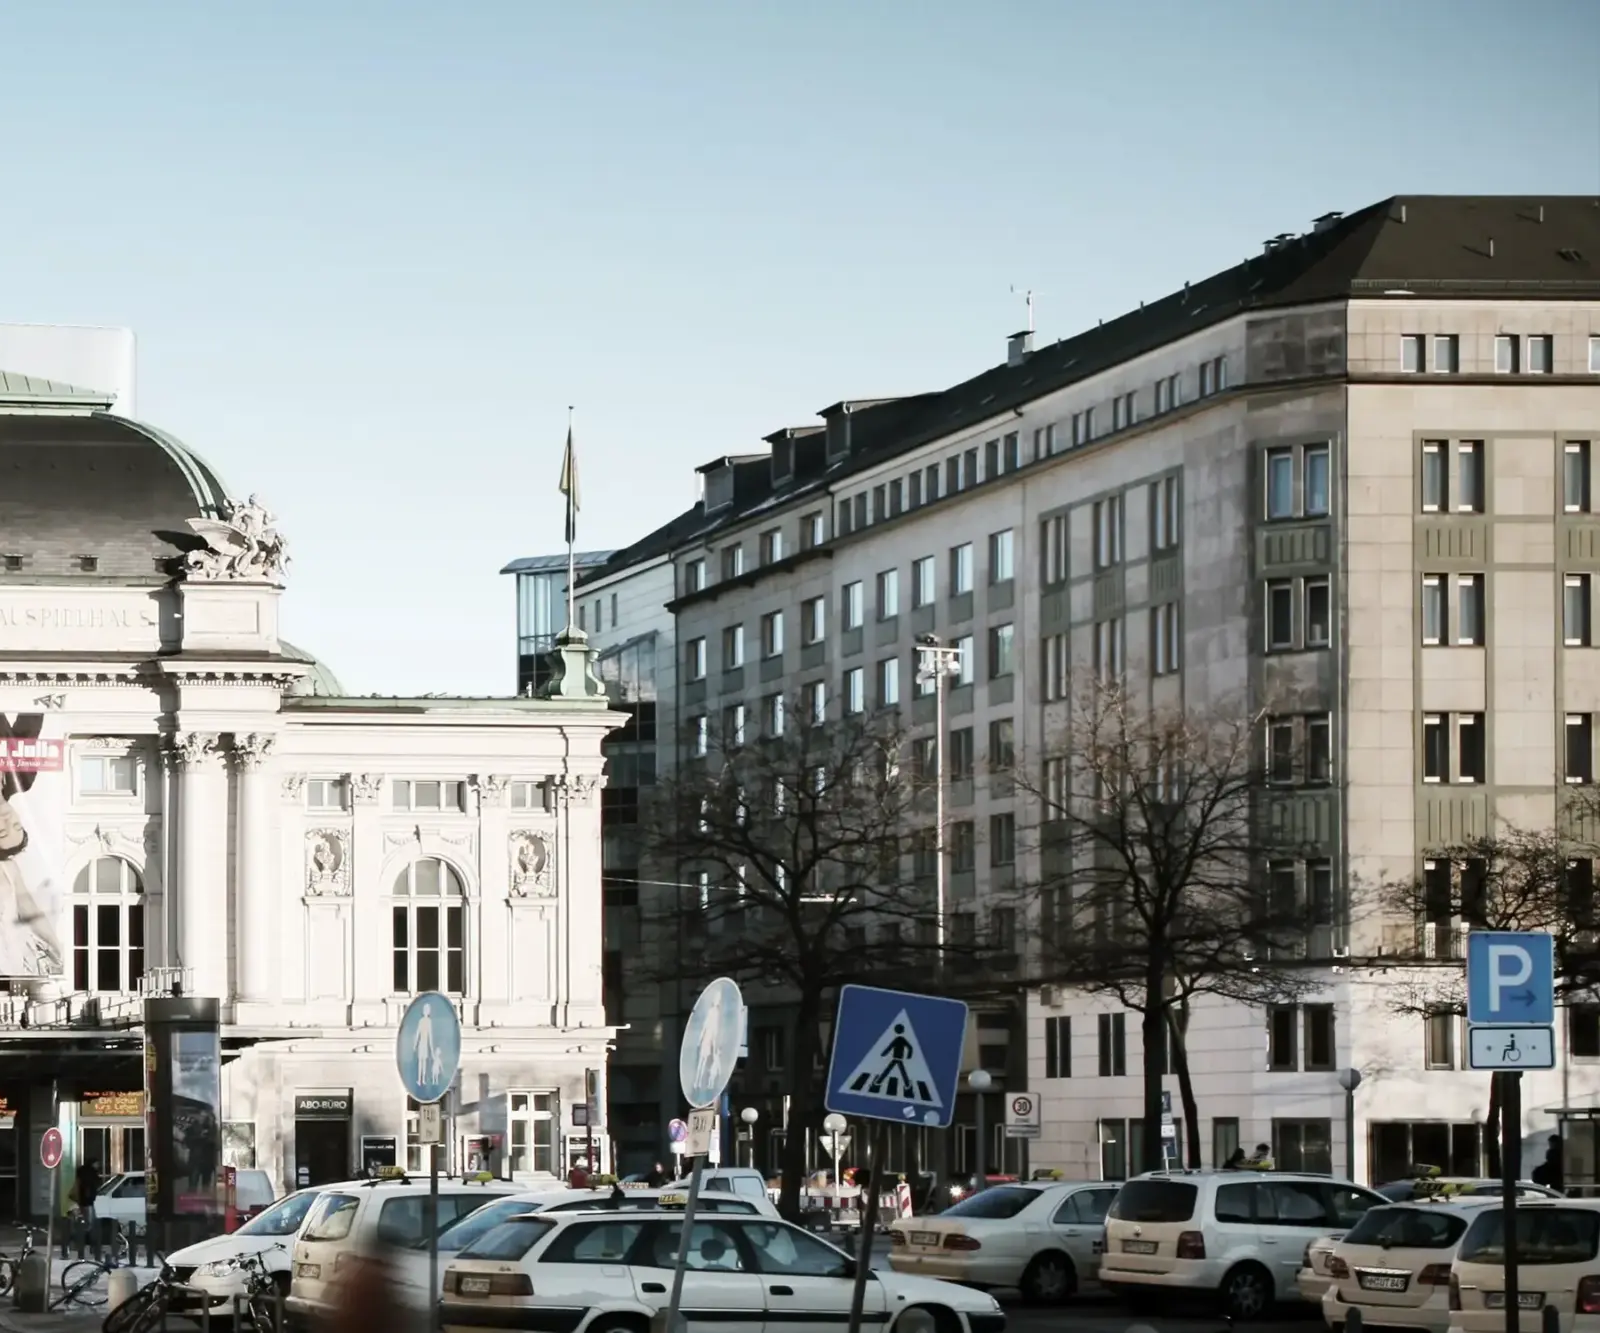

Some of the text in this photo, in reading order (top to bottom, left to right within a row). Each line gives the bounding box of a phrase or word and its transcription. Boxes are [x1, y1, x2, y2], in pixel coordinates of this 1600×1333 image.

[11, 740, 59, 758] Julia
[1488, 944, 1532, 1012] P
[299, 1099, 348, 1110] ABO-BÜRO
[1016, 1101, 1028, 1112] 30
